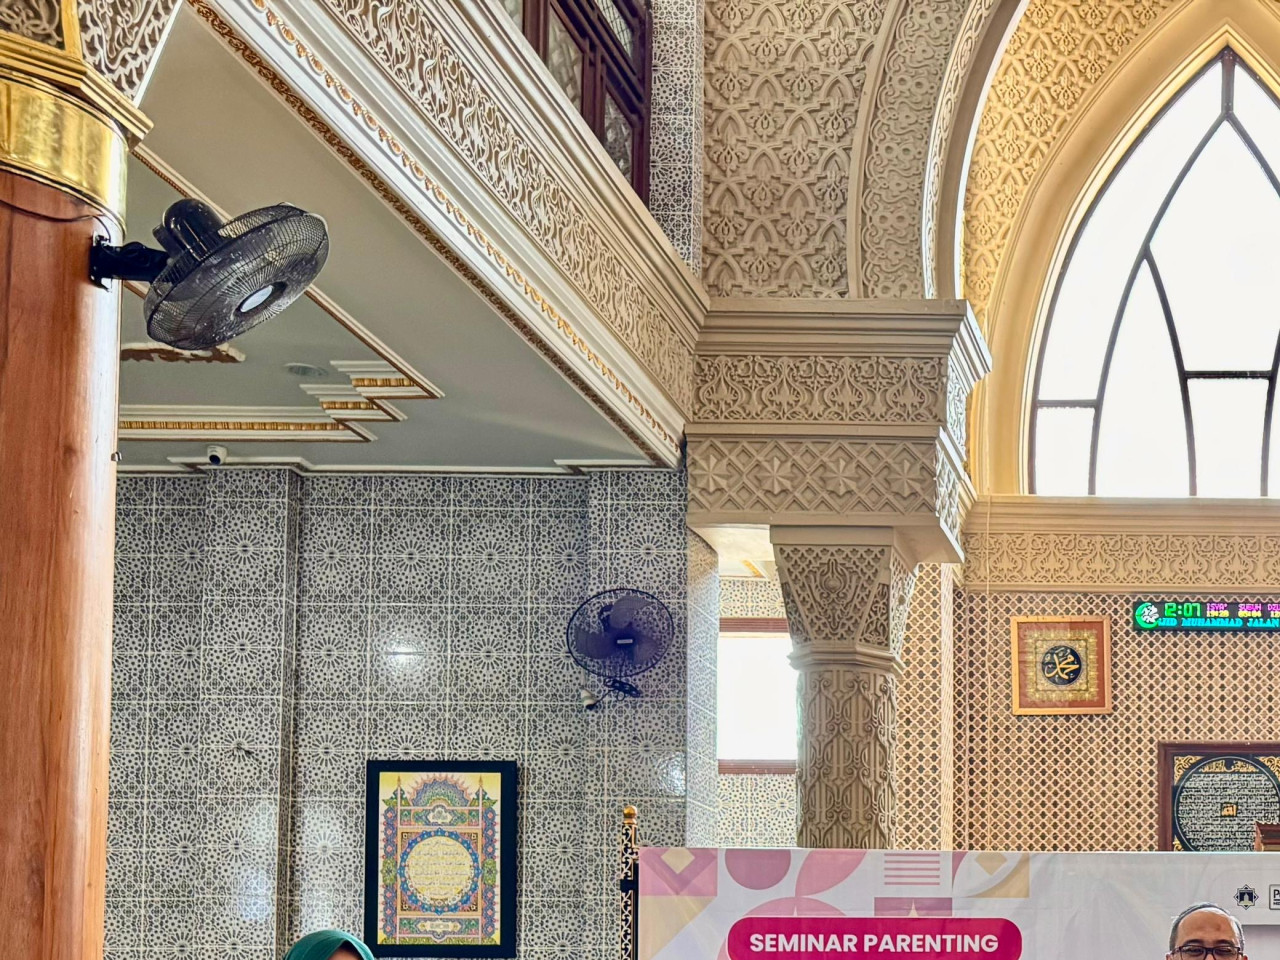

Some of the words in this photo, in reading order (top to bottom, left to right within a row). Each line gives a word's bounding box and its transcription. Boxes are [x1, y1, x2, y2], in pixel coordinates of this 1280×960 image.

[1238, 603, 1261, 611] SUBUH
[1181, 617, 1243, 627] MUHAMMAD
[1247, 618, 1280, 628] JALAN
[750, 933, 857, 953] SEMINAR
[864, 933, 999, 953] PARENTING
